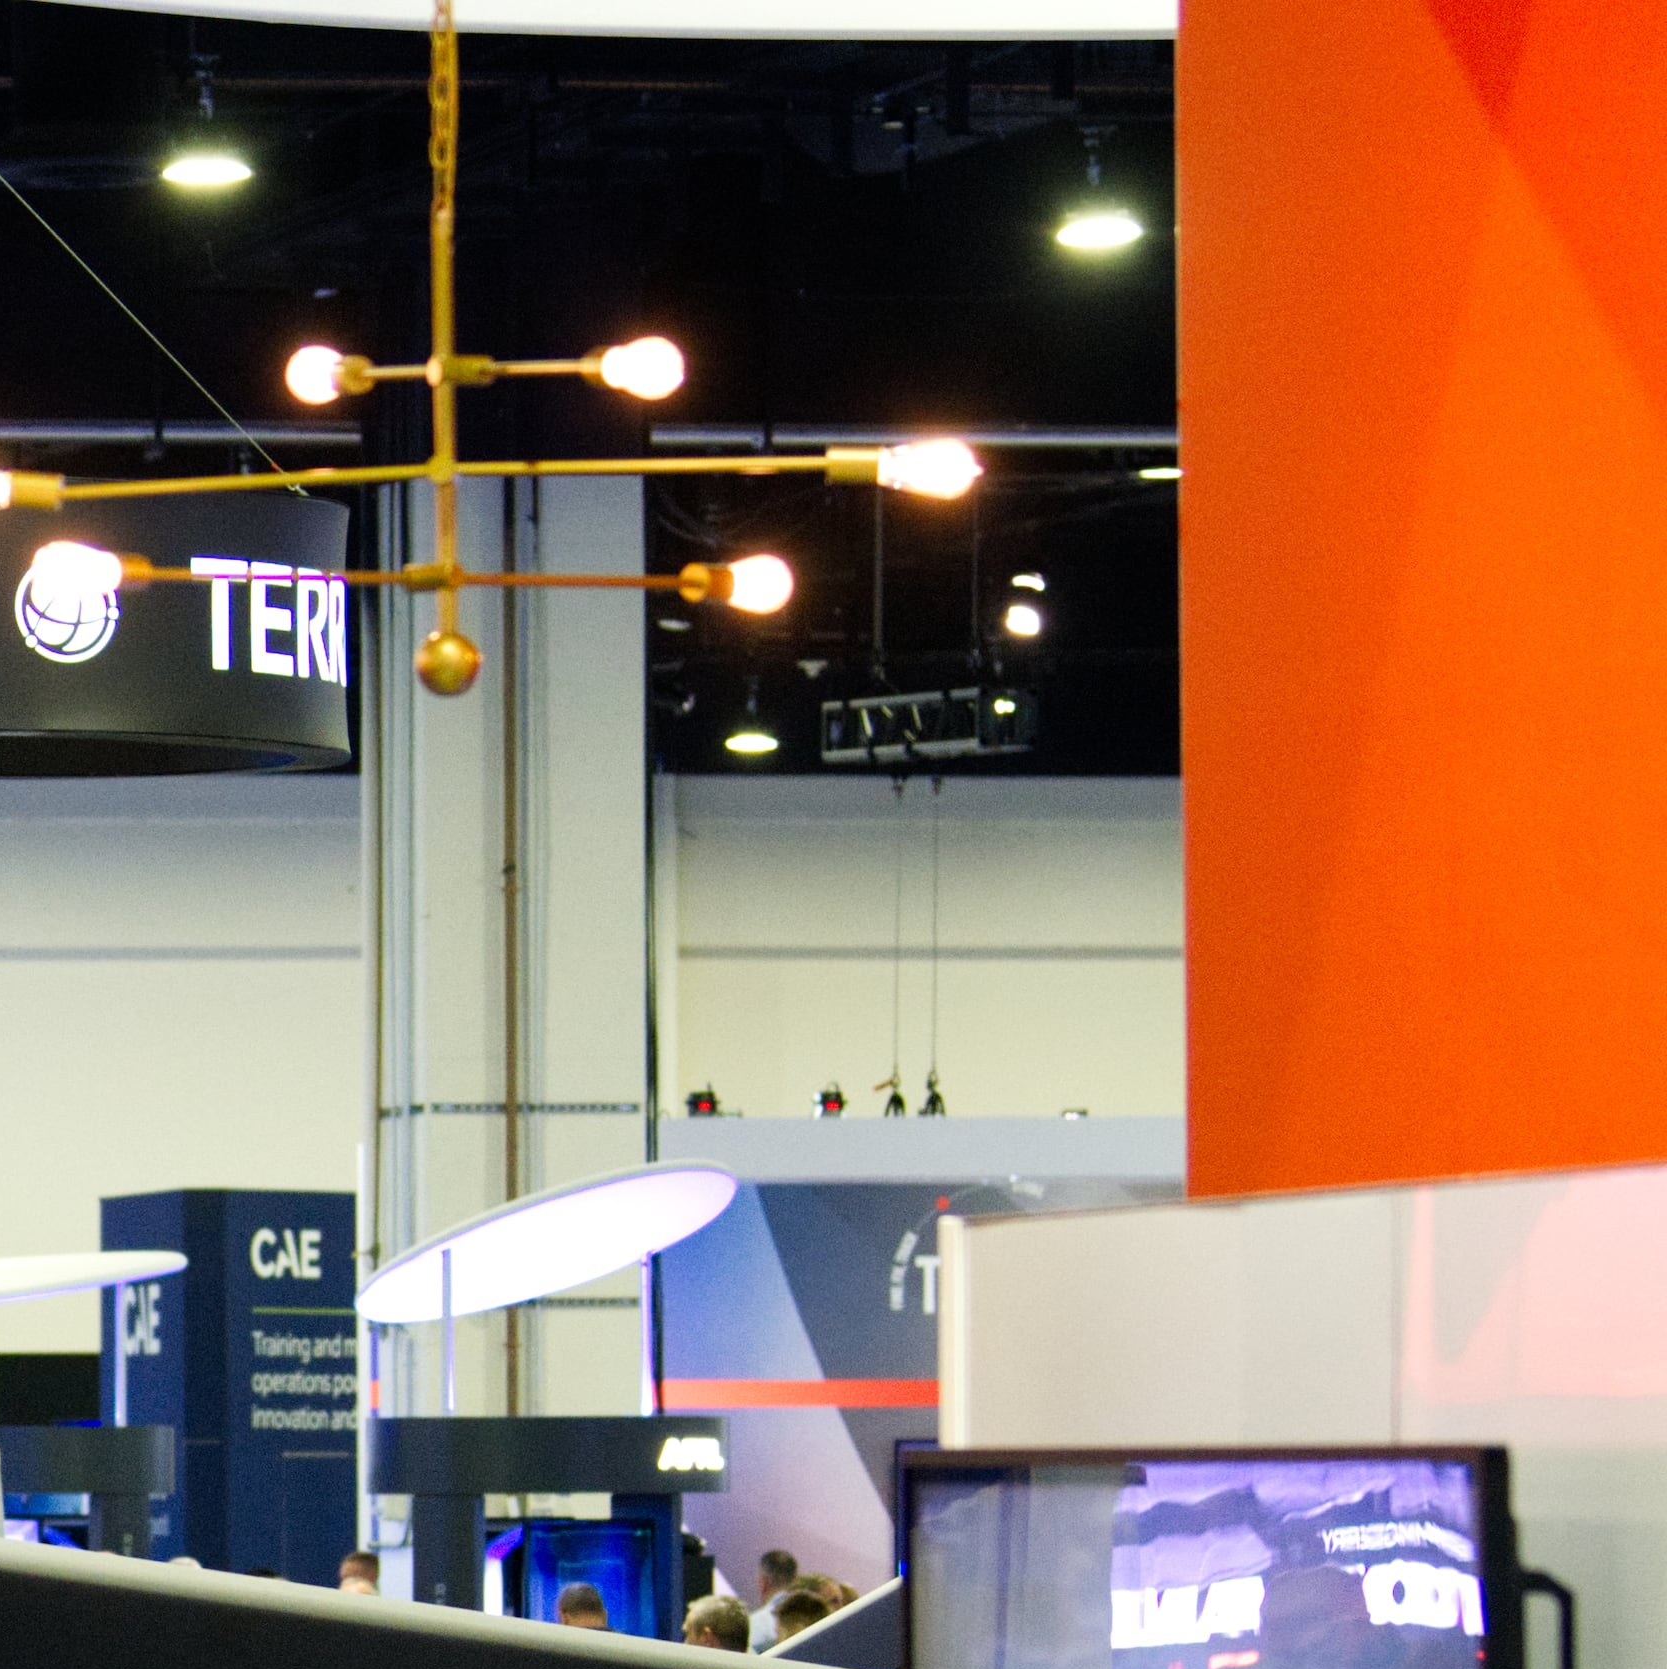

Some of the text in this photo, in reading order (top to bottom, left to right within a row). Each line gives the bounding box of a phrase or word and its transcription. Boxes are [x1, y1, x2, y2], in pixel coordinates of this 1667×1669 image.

[250, 1228, 322, 1280] CAE
[251, 1330, 311, 1365] Training
[314, 1332, 341, 1358] and
[251, 1369, 357, 1399] operations po
[251, 1405, 328, 1430] innovation
